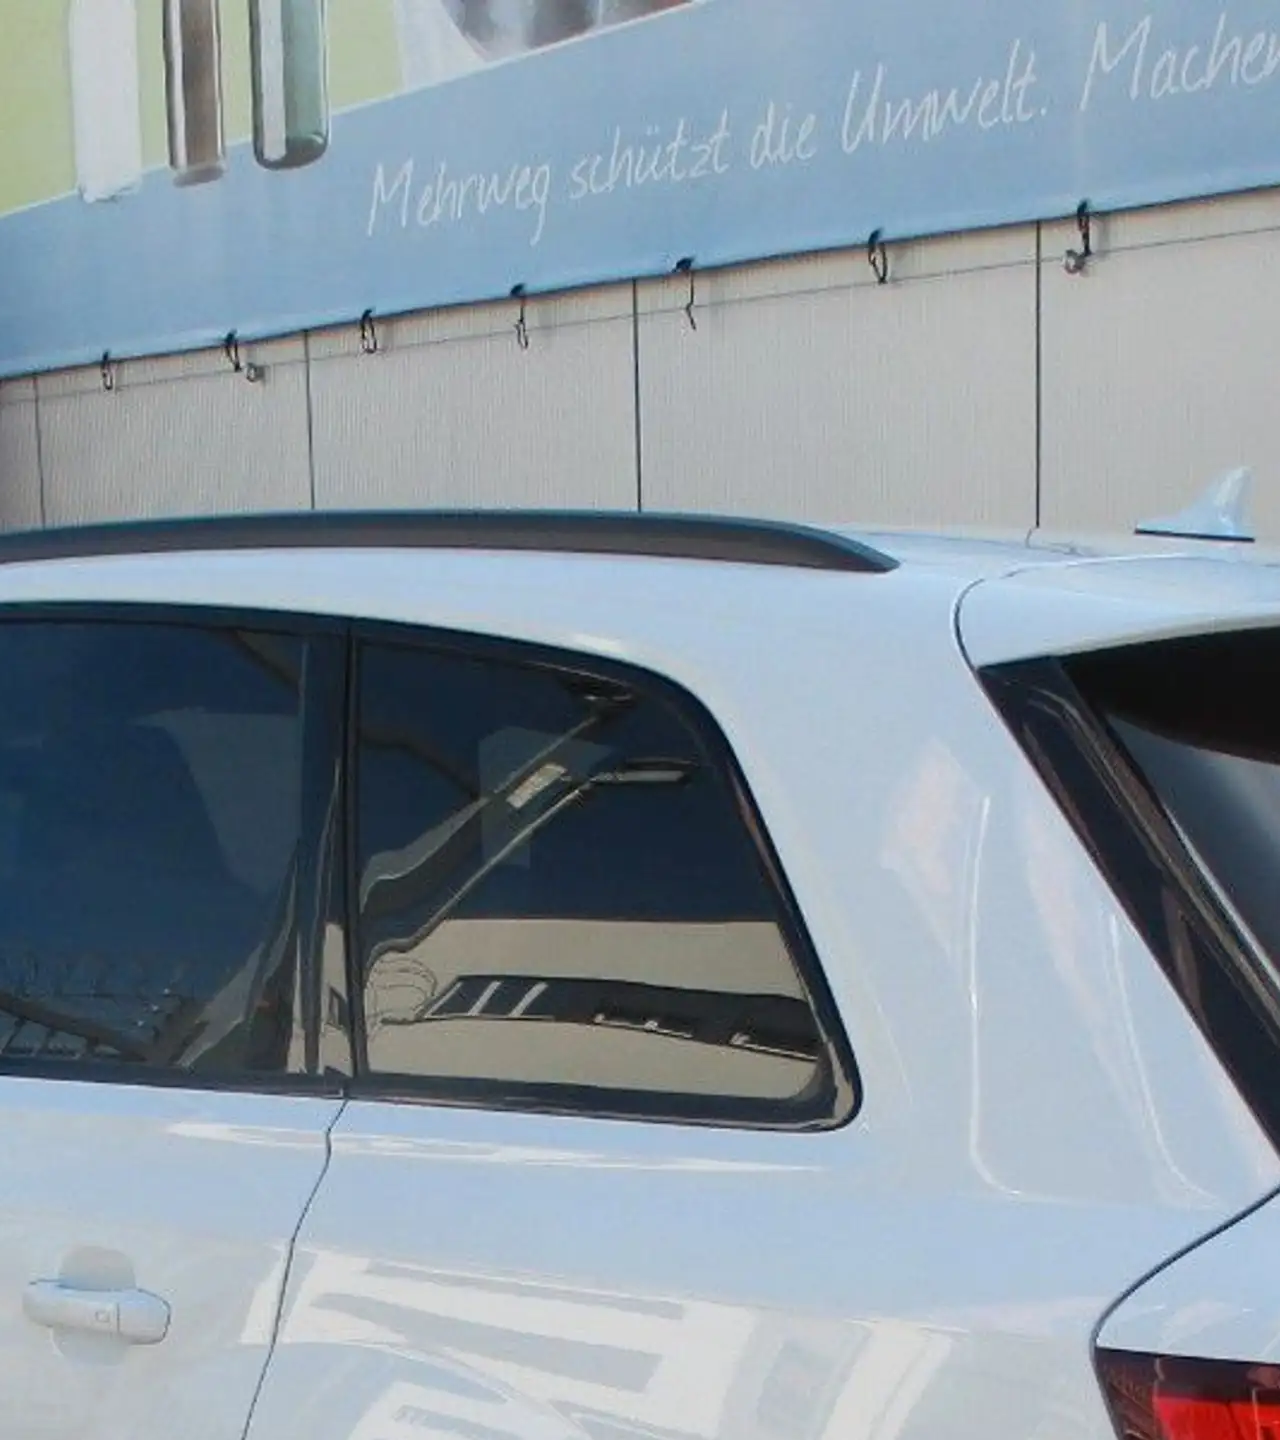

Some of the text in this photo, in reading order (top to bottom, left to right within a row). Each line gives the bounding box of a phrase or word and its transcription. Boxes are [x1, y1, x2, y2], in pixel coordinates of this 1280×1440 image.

[367, 157, 552, 247] Mehrweg
[569, 107, 731, 200] schützt
[749, 101, 817, 169] die
[840, 37, 1048, 155] Umwelt.
